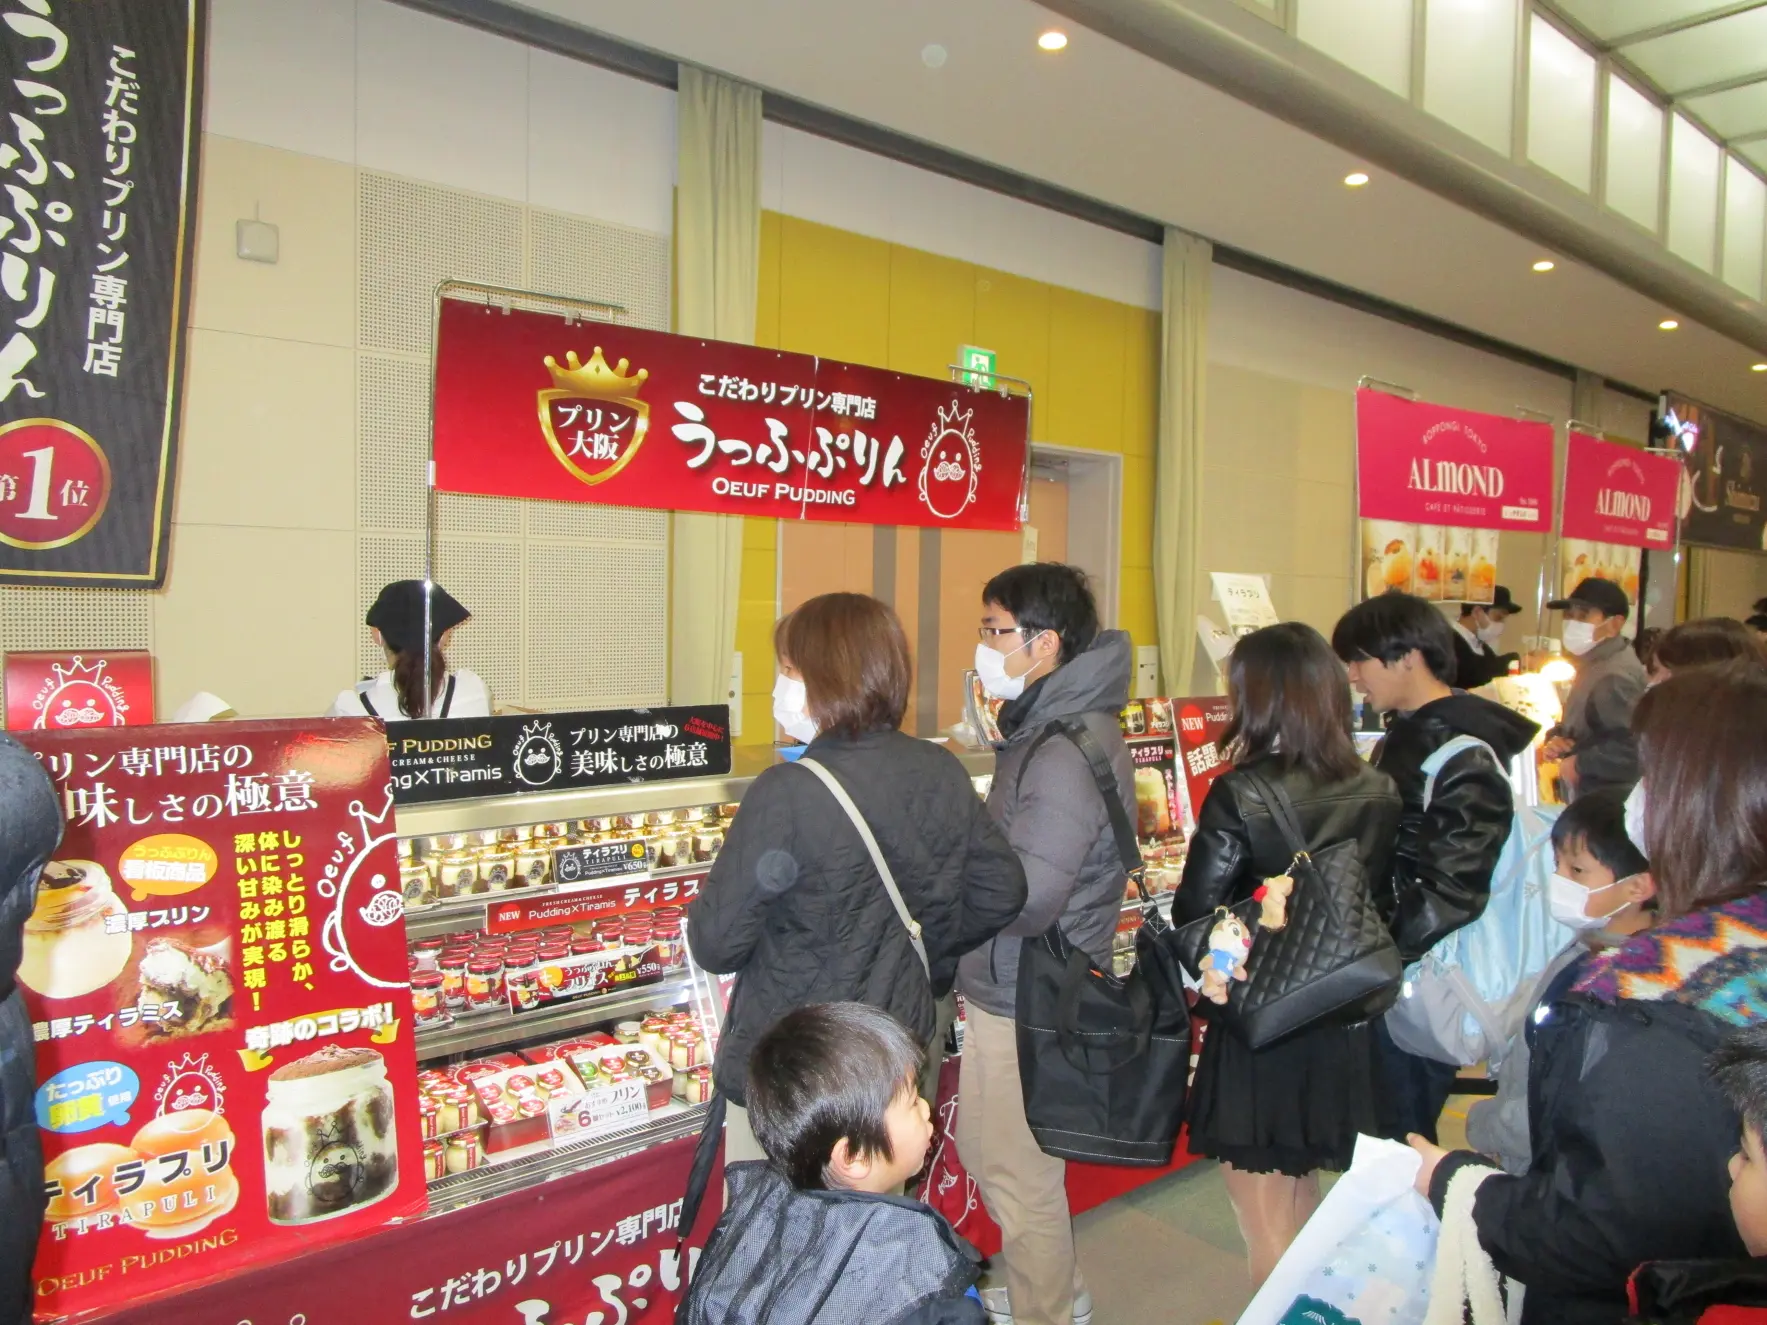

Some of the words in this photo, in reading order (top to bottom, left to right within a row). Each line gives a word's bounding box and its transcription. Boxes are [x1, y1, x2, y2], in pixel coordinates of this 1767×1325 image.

[83, 44, 140, 378] こだわりプリン専門店
[698, 373, 877, 419] こだわりプリン専門店
[557, 405, 631, 435] プリン
[567, 433, 620, 461] 大阪
[672, 402, 907, 488] うっふぷりん
[1464, 425, 1488, 453] TOKYO
[712, 476, 770, 500] OEUF
[774, 482, 856, 507] PUDDING
[1181, 717, 1204, 731] NEW
[403, 734, 492, 754] PUDDING
[571, 742, 708, 777] 美味しさの極意
[34, 744, 253, 781] リン専門店の
[258, 832, 288, 962] 体に染み渡る
[498, 911, 520, 922] NEW
[46, 1066, 121, 1102] たっぷり
[53, 1185, 216, 1240] TIRAPULI
[36, 1264, 113, 1297] OEUF
[121, 1228, 238, 1277] PUDDING
